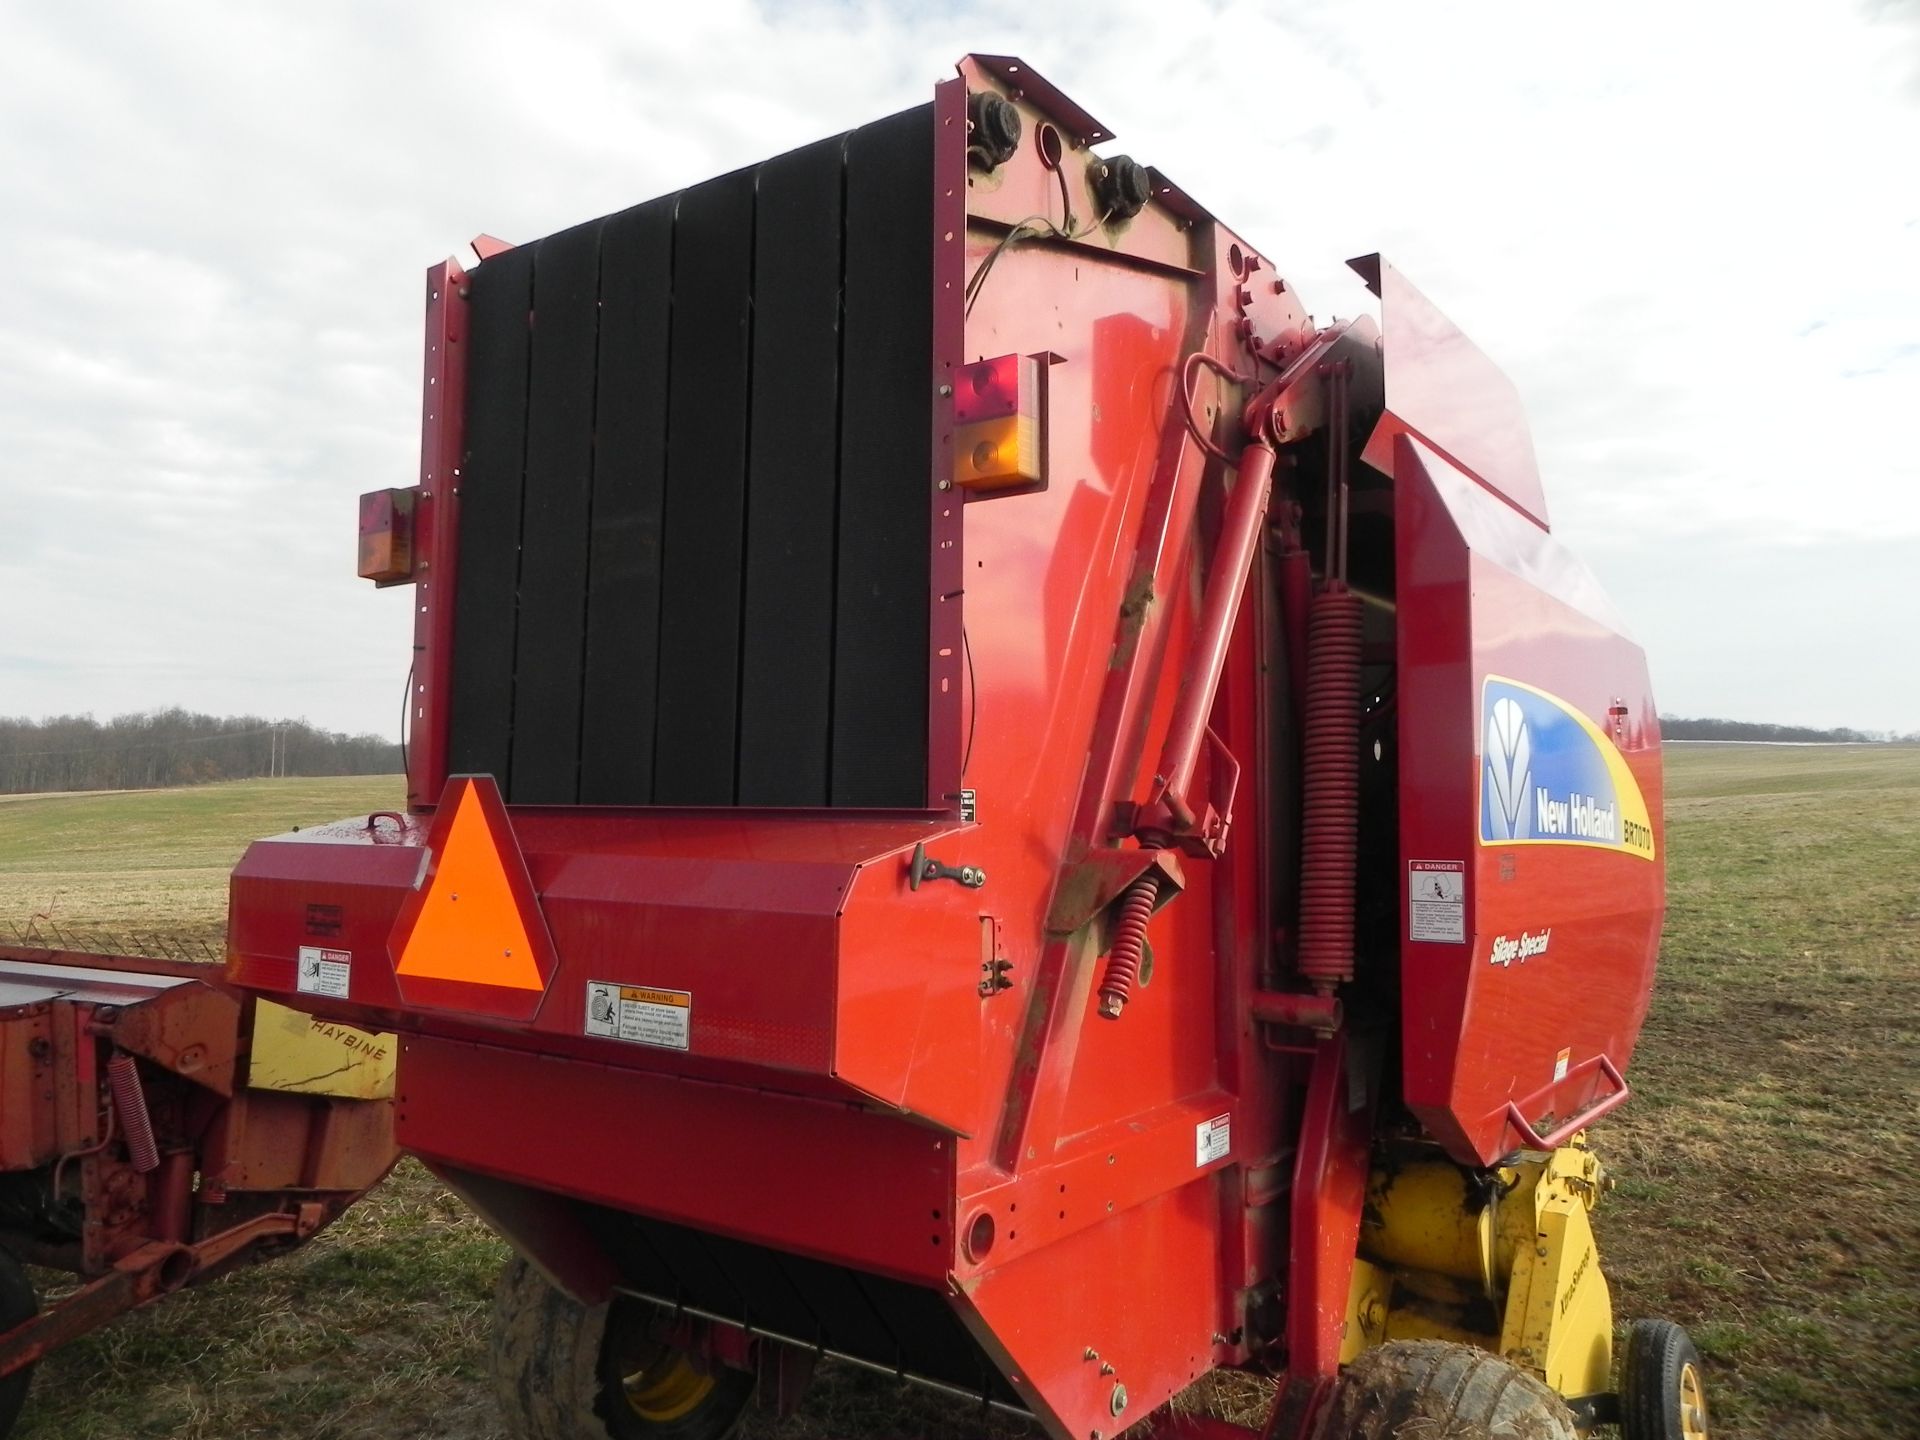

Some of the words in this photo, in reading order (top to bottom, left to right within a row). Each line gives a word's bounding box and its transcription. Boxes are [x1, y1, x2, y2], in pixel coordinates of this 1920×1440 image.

[1536, 787, 1568, 834] New
[1570, 792, 1615, 840] Holland
[1623, 819, 1651, 850] BR7070
[1424, 863, 1459, 871] DANGER
[327, 952, 349, 962] DANGER
[1490, 934, 1519, 968] Silage
[1518, 928, 1551, 964] Special
[639, 992, 674, 1003] WARNING
[311, 1020, 387, 1061] HAYBINE
